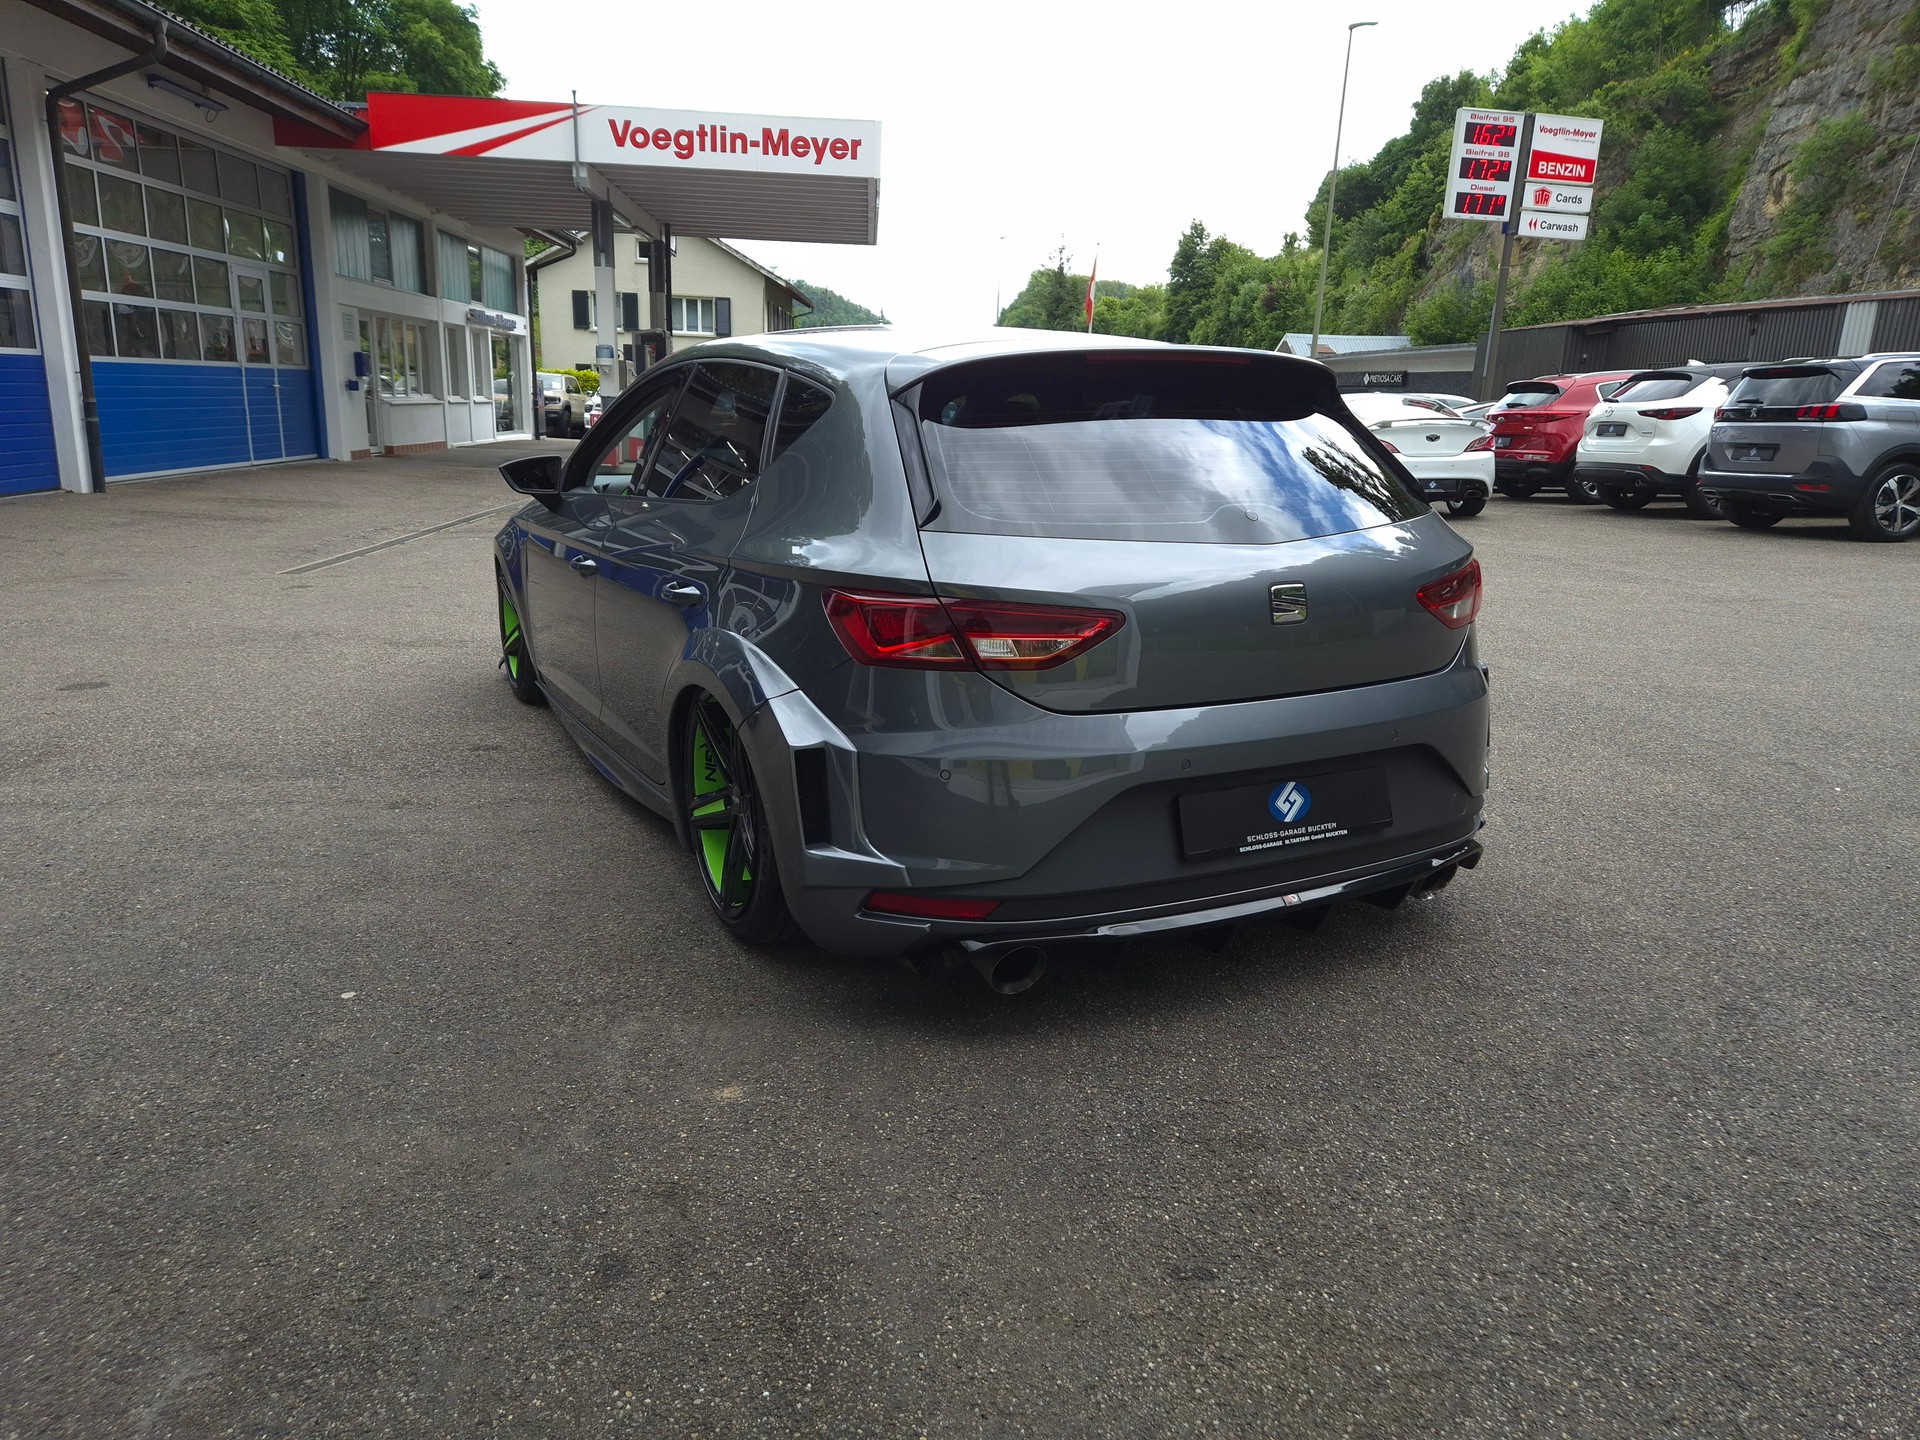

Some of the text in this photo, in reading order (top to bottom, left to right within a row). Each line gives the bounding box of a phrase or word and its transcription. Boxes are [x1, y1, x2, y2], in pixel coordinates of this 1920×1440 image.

[1470, 112, 1500, 122] Bleifrei
[1539, 124, 1598, 139] Voegtlin-Meyer
[607, 118, 862, 165] Voegtlin-Meyer
[1465, 148, 1510, 158] Bleifrei 98
[1537, 160, 1586, 178] BENZIN
[1470, 183, 1496, 192] Diesel
[1555, 192, 1583, 205] Cards
[1540, 220, 1579, 233] Carwash
[1390, 374, 1403, 383] CARS
[1246, 822, 1337, 843] SCHLOSS-GARAGE BUCKTEN
[1239, 840, 1283, 853] SCHLOSS-GARAGE
[1310, 833, 1326, 841] GmbH
[1325, 829, 1348, 838] BUCKTEN
